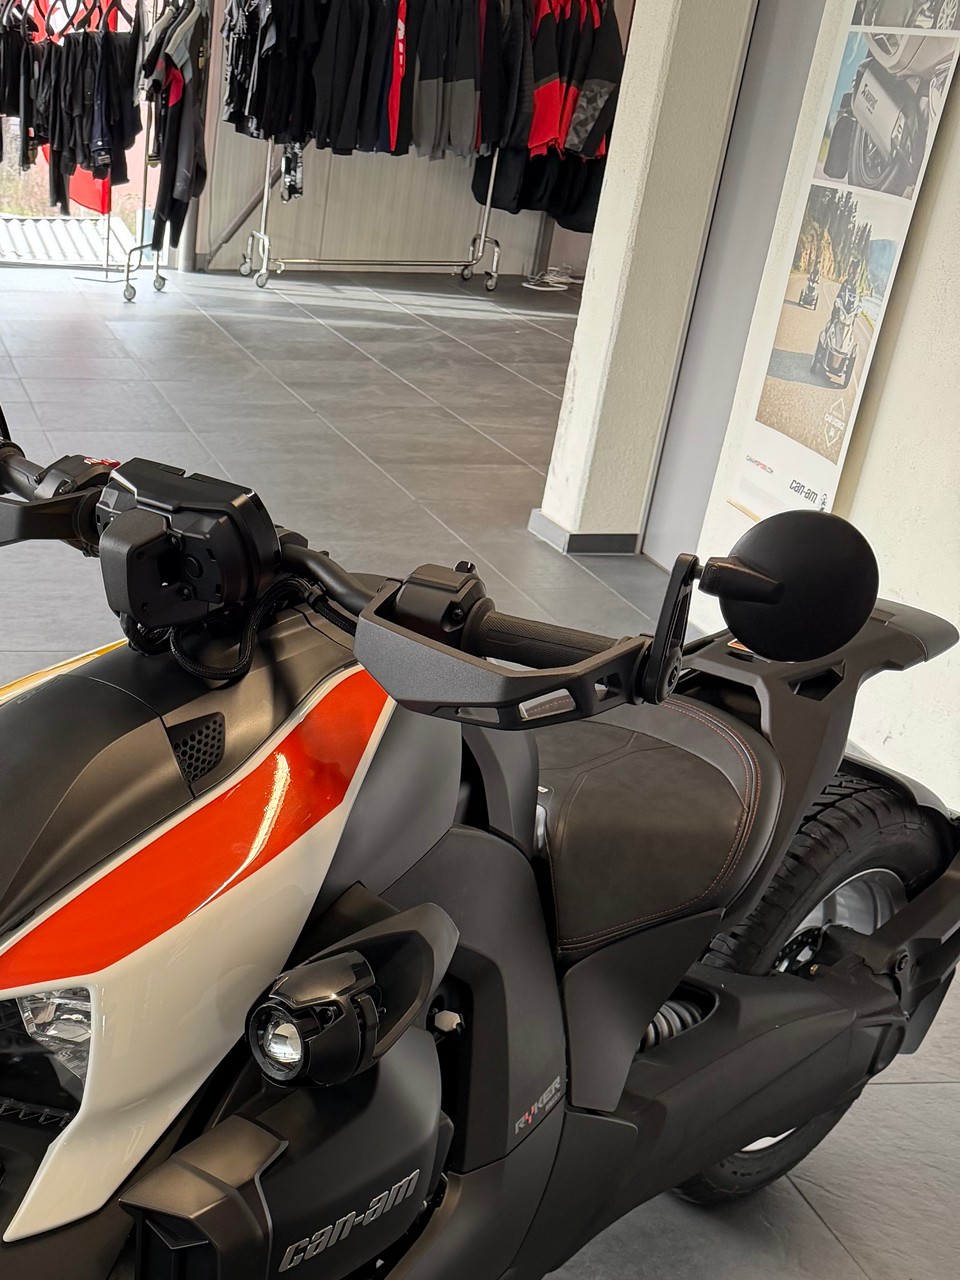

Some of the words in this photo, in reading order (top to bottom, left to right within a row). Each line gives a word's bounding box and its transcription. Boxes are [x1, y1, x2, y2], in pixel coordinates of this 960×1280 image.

[789, 479, 819, 504] can-am
[514, 1075, 561, 1135] RYKER
[277, 1168, 420, 1273] can-am
